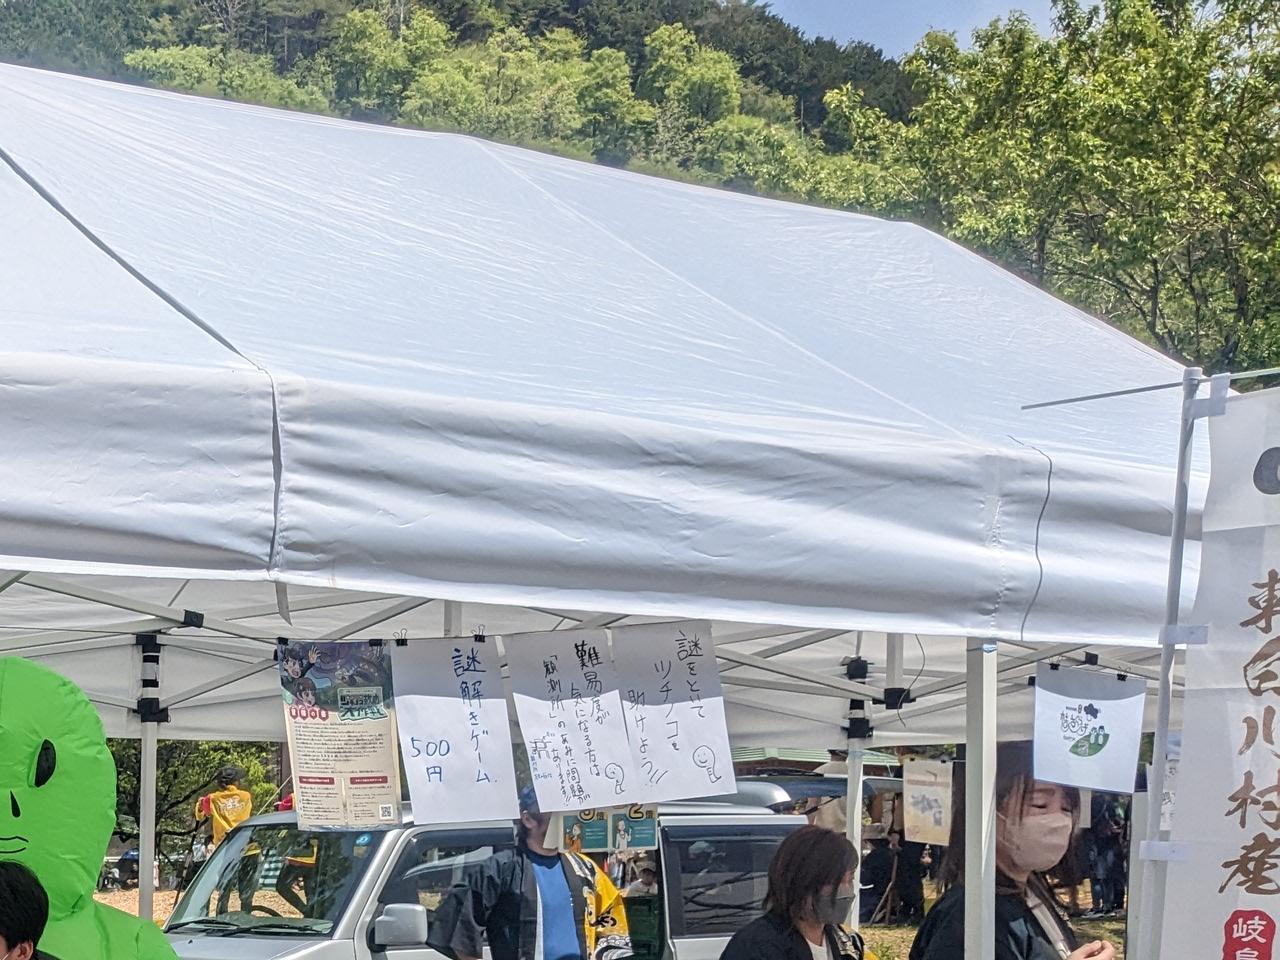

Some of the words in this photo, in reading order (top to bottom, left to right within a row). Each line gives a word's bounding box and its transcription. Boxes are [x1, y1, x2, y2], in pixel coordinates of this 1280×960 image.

[574, 640, 610, 725] 難易度が
[411, 736, 451, 758] 500
[426, 766, 443, 783] 円
